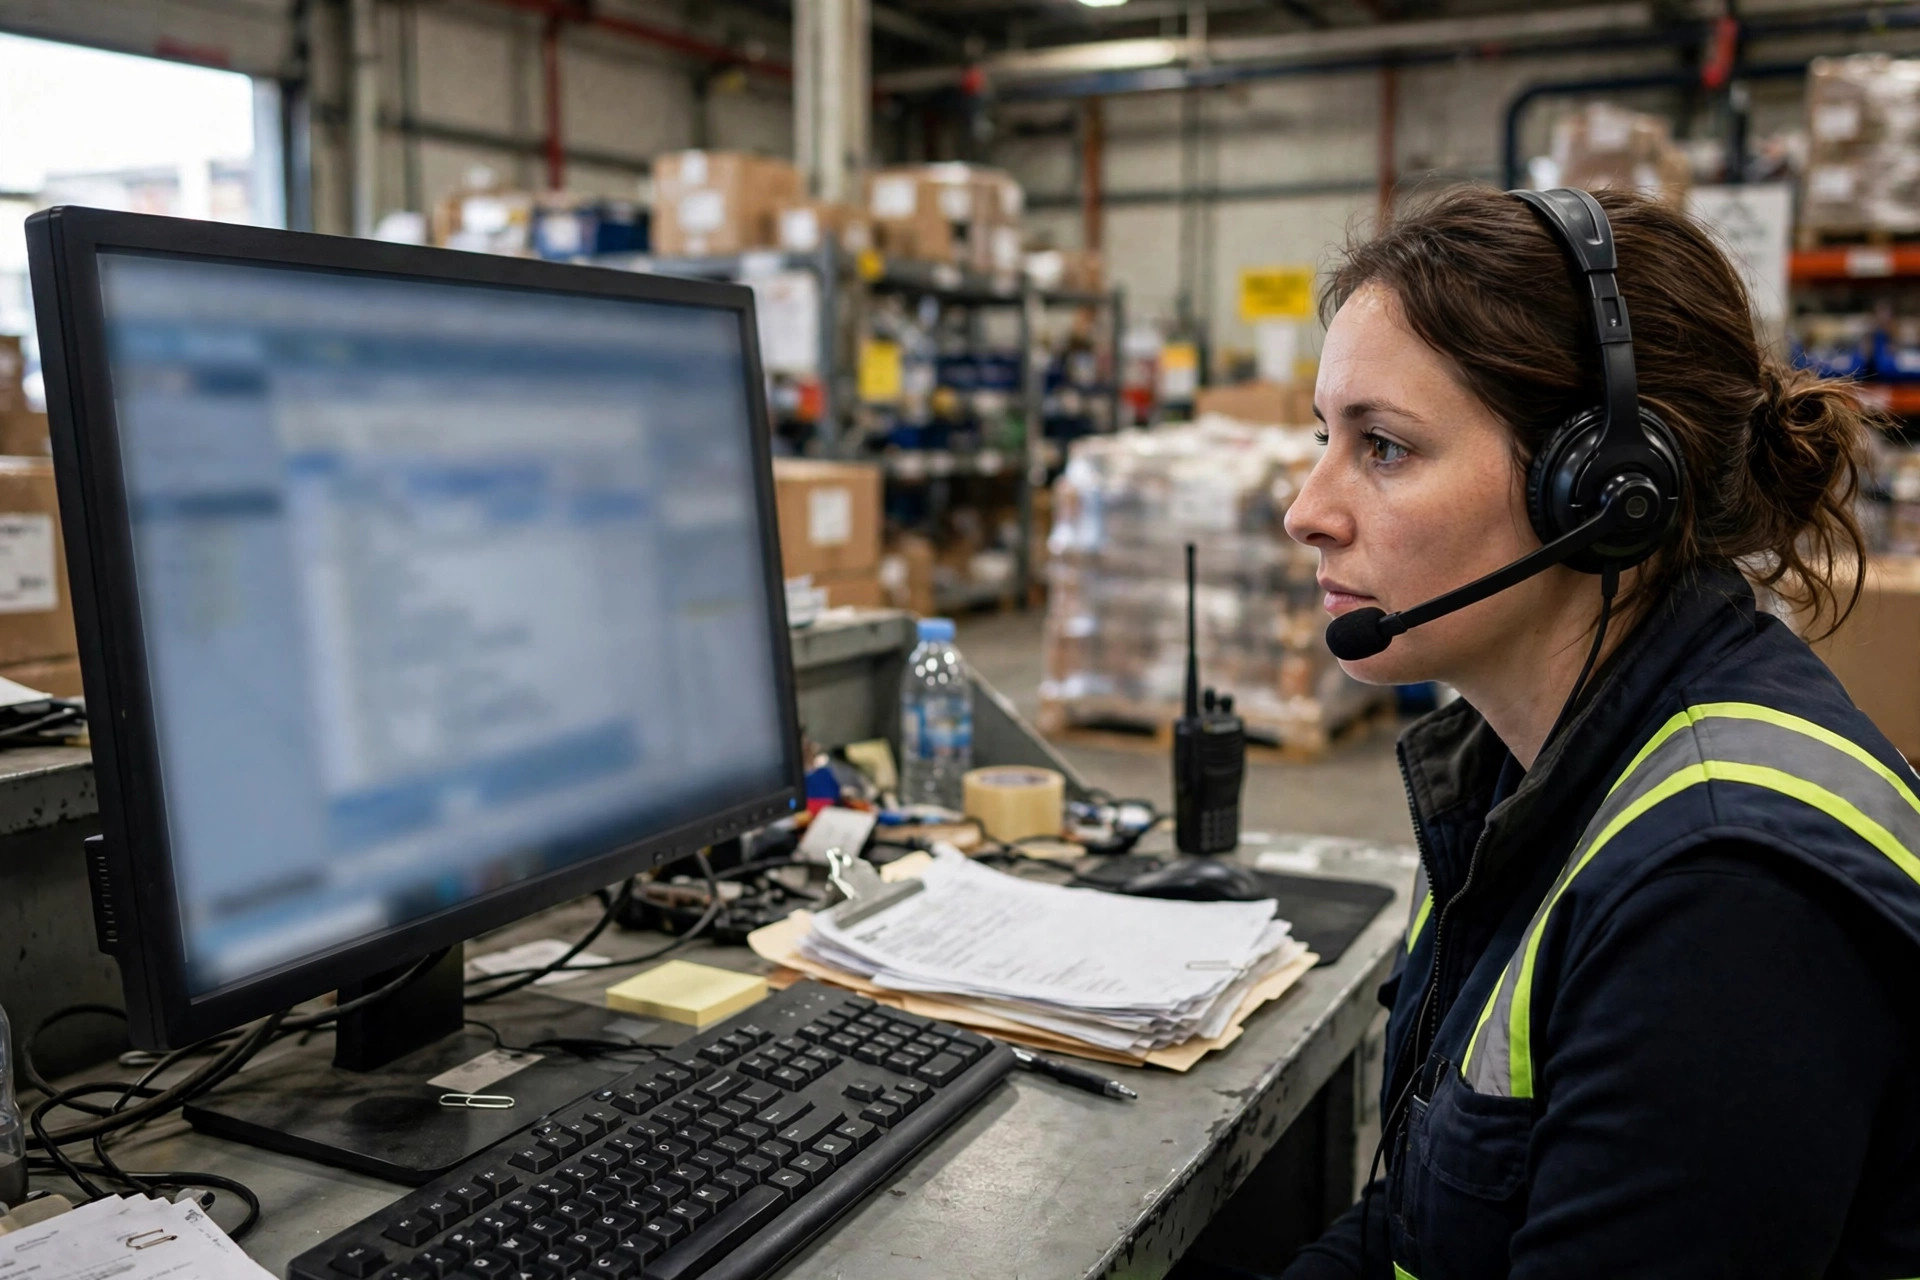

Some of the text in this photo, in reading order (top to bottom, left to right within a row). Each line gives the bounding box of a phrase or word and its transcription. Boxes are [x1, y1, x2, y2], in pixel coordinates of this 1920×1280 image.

[658, 1143, 670, 1152] O
[634, 1158, 647, 1166] U
[608, 1173, 621, 1181] Y
[675, 1168, 688, 1177] K
[585, 1188, 597, 1196] T
[652, 1184, 662, 1193] J
[560, 1204, 574, 1213] R
[601, 1216, 615, 1225] G
[531, 1222, 546, 1231] E
[647, 1223, 661, 1232] B
[501, 1237, 519, 1249] W
[573, 1234, 588, 1243] D
[621, 1239, 635, 1248] V
[546, 1252, 560, 1261] S
[597, 1258, 611, 1268] C
[519, 1271, 533, 1280] A
